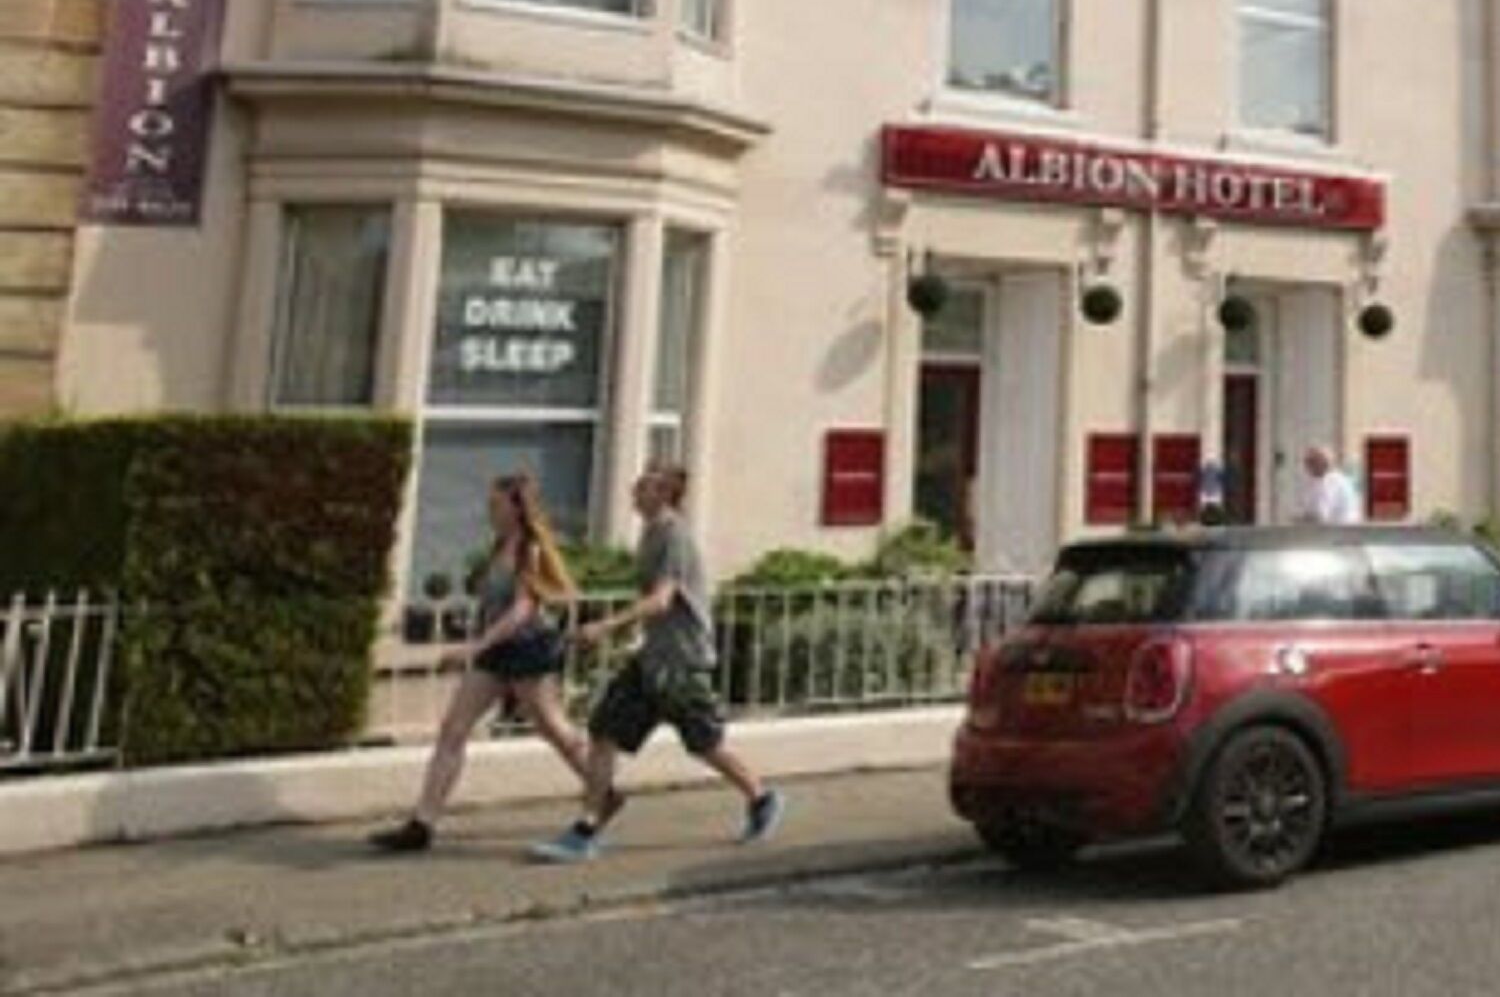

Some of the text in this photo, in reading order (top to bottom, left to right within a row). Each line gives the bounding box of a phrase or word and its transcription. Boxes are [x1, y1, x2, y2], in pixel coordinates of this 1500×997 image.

[973, 142, 1326, 215] ALBION HOTEL
[489, 256, 557, 287] EAT
[465, 296, 576, 331] DRINK
[460, 336, 575, 371] SLEEP
